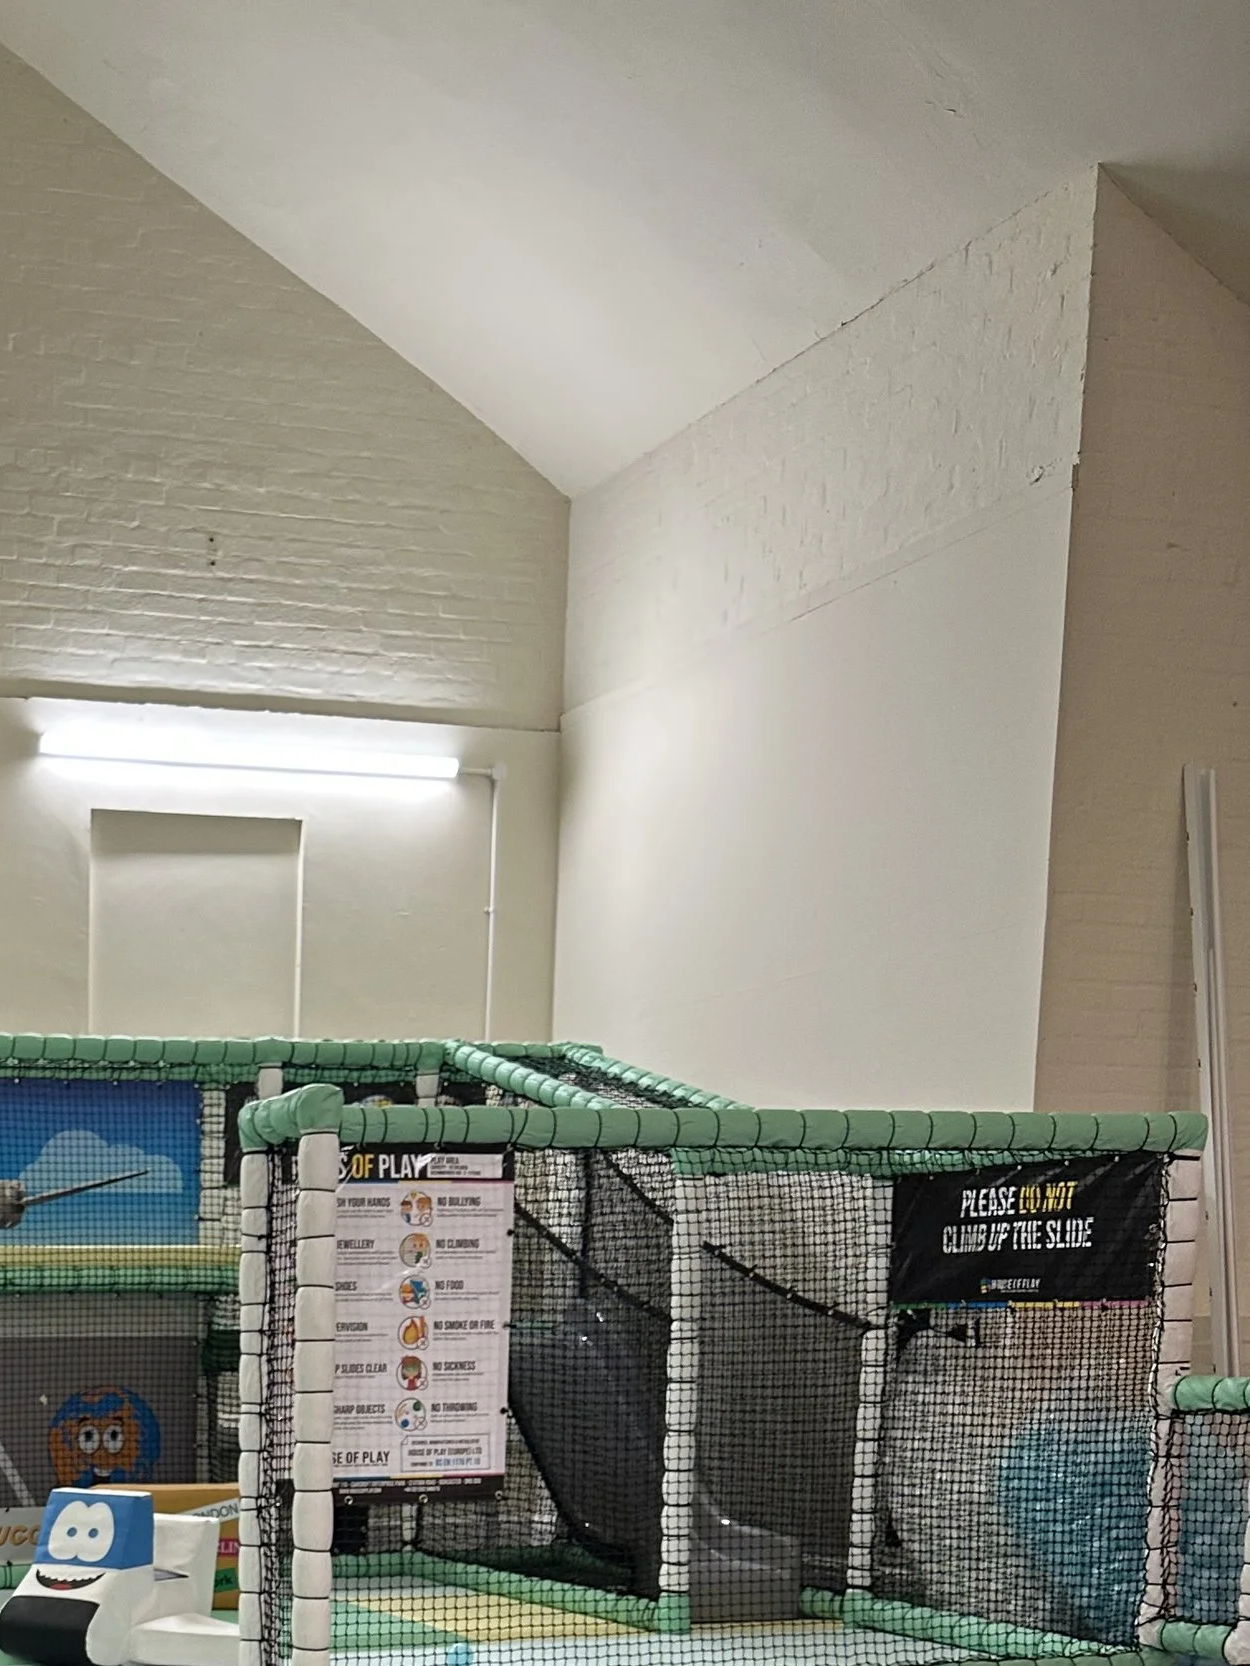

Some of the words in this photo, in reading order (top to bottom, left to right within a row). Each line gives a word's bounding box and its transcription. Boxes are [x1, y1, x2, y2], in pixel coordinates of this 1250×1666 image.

[352, 1153, 374, 1179] OF
[378, 1153, 422, 1179] PLAY
[367, 1197, 390, 1207] HANDS
[437, 1197, 447, 1206] NO
[960, 1186, 1017, 1218] PLEASE
[1018, 1184, 1041, 1214] DO
[1042, 1181, 1078, 1212] NOT
[942, 1223, 987, 1254] CLIMB
[987, 1222, 1010, 1251] UP
[1013, 1219, 1042, 1250] THE
[1045, 1217, 1094, 1249] SLIDE
[436, 1239, 445, 1248] NO
[435, 1280, 445, 1290] NO
[446, 1280, 464, 1290] FOOD
[434, 1320, 443, 1330] NO
[444, 1320, 467, 1330] SMOKE
[469, 1320, 478, 1329] OR
[480, 1319, 495, 1330] FIRE
[341, 1364, 364, 1374] SLIDES
[365, 1363, 387, 1373] CLEAR
[432, 1362, 442, 1371] NO
[444, 1361, 476, 1371] SICKNESS
[356, 1404, 385, 1414] OBJECTS
[431, 1403, 441, 1412] NO
[442, 1402, 478, 1412] THROWING
[346, 1452, 359, 1464] OF
[362, 1451, 390, 1464] PLAY
